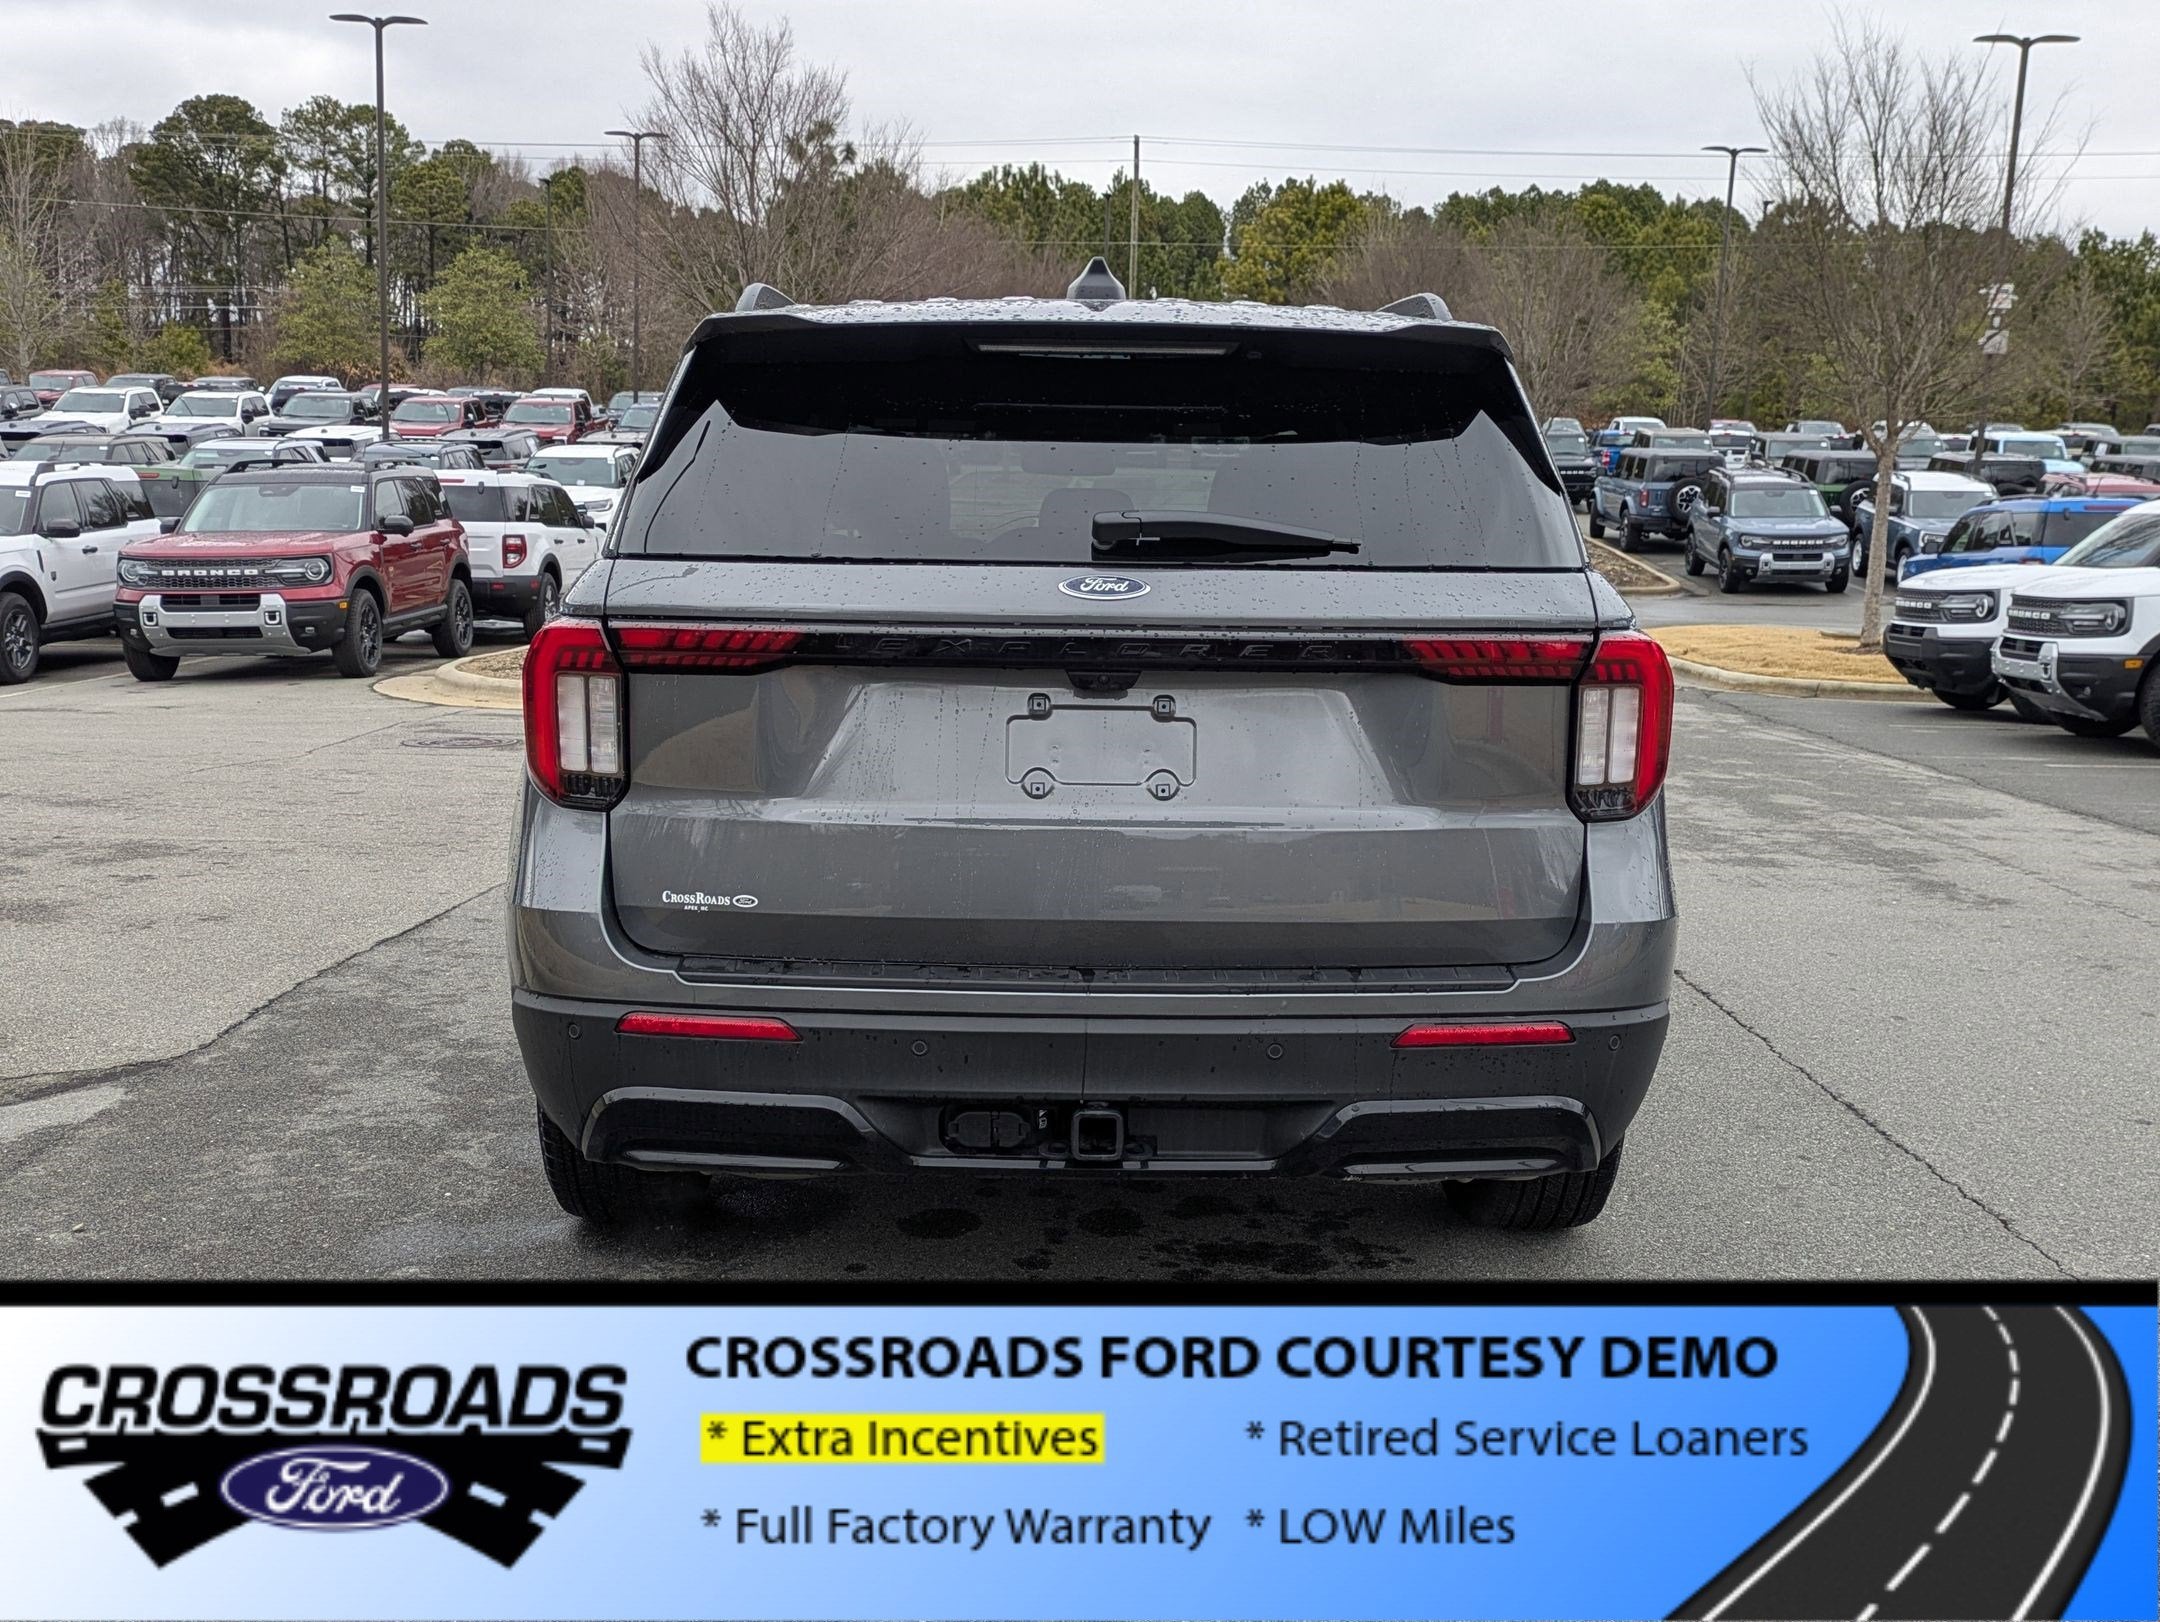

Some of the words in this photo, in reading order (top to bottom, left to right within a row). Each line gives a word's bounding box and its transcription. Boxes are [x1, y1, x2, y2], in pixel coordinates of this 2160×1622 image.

[161, 568, 259, 577] BRONCO
[1080, 577, 1130, 592] Ford
[873, 637, 1334, 660] EXPLORER
